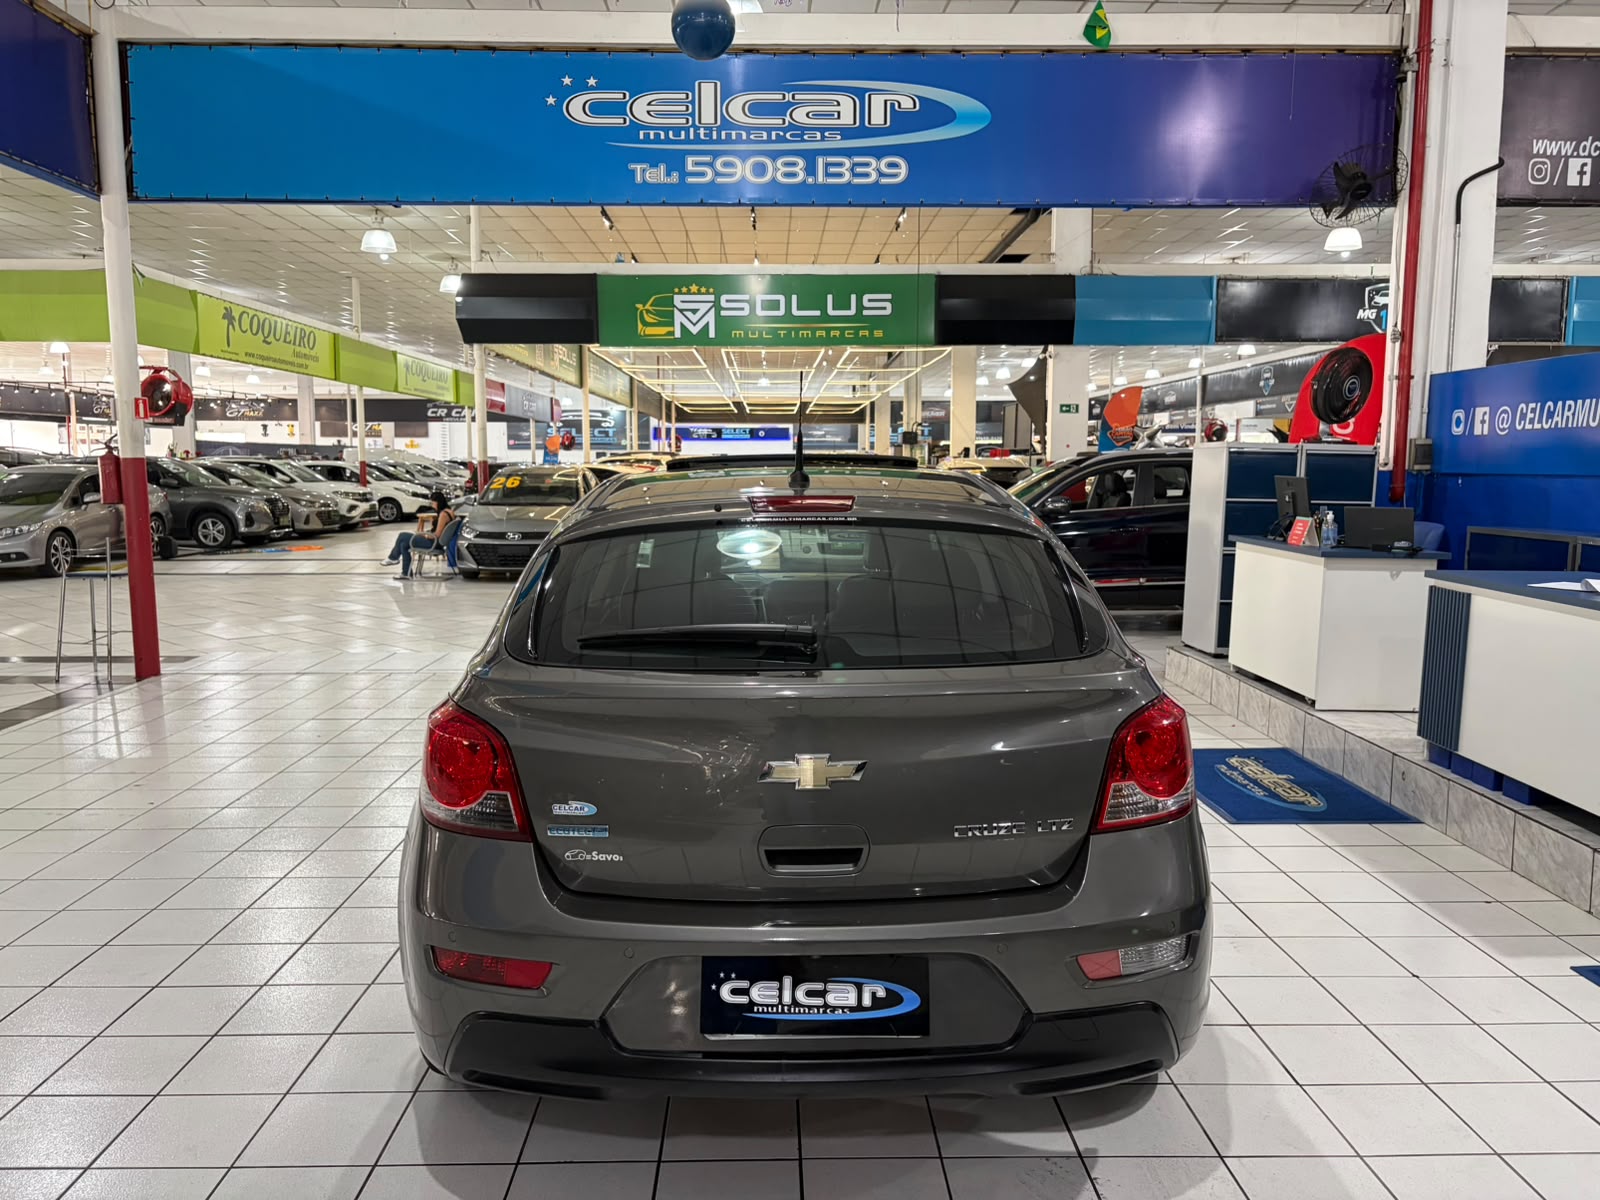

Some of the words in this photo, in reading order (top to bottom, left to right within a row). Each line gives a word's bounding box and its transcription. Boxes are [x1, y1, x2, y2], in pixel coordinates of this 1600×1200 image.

[562, 80, 920, 127] celcar
[638, 127, 842, 141] multimarcas
[628, 163, 679, 184] Tel.:
[685, 155, 909, 184] 5908.1339
[719, 293, 892, 316] SOLUS
[1356, 309, 1378, 320] MG
[237, 310, 317, 351] COQUEIRO
[731, 329, 885, 339] MULTIMARCAS
[409, 358, 450, 386] COQUEIRO
[426, 407, 448, 418] CR
[1515, 398, 1600, 431] CELCARMU
[546, 427, 617, 438] SELCT
[490, 476, 522, 489] 26
[552, 804, 586, 812] CELCAR
[954, 822, 1026, 838] CRUZE
[1037, 818, 1074, 832] LTZ
[719, 975, 887, 1008] celcar
[753, 1004, 851, 1015] multimarcas
